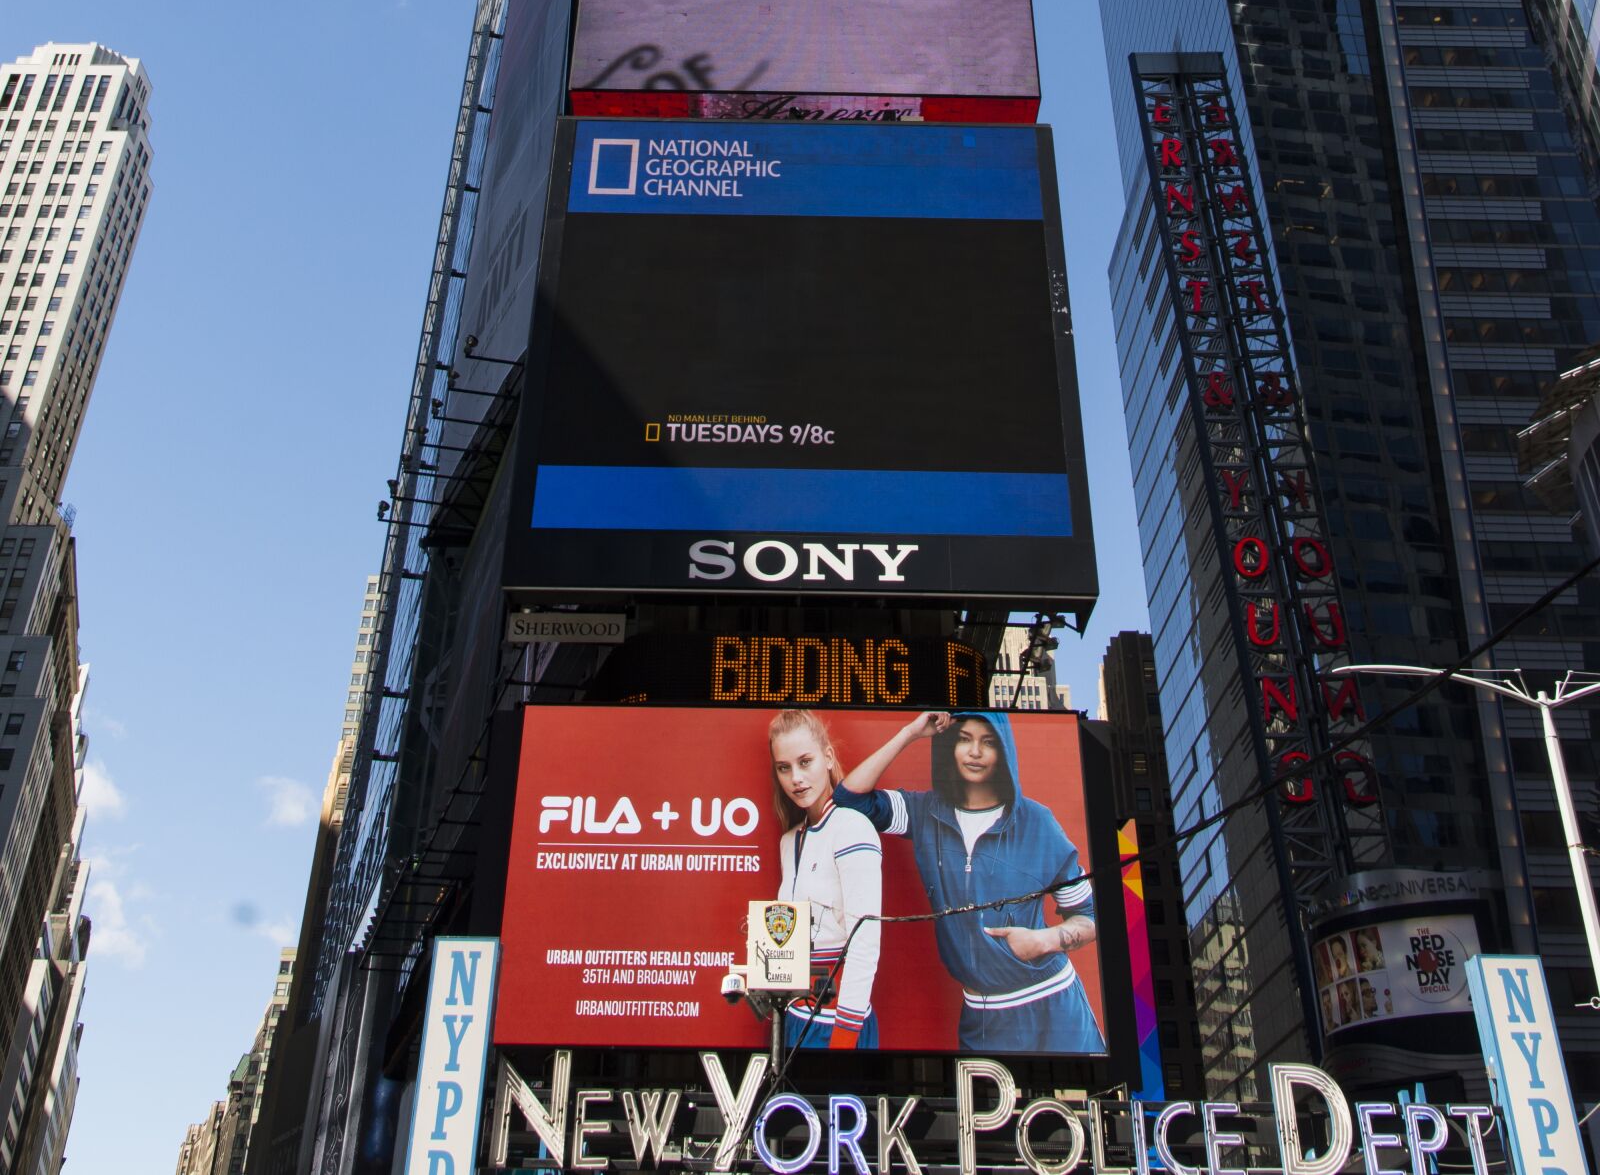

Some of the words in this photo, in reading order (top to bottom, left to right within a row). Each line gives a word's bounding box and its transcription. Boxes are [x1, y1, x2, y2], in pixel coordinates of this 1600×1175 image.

[648, 139, 754, 158] NATIONAL
[645, 158, 782, 178] GEOGRAPHIC
[643, 178, 743, 197] CHANNEL
[1204, 372, 1233, 406] &
[668, 414, 682, 423] NO
[683, 415, 705, 423] MAN
[706, 415, 729, 423] LEFT
[731, 415, 767, 424] BEHIND
[666, 423, 784, 444] TUESDAYS
[789, 423, 836, 446] 9/8c
[687, 538, 919, 583] SONY
[513, 619, 620, 636] SHERWOOD
[711, 636, 910, 704] BIDDING
[947, 641, 985, 707] F
[539, 795, 642, 834] FILA
[652, 801, 680, 831] +
[691, 797, 760, 837] UO
[536, 852, 620, 870] EXCLUSIVELY
[621, 853, 639, 870] AT
[640, 853, 683, 871] URBAN
[686, 854, 761, 873] OUTFITTERS
[1416, 927, 1430, 936] THE
[765, 948, 793, 958] SECURITY
[1409, 934, 1445, 953] RED
[546, 949, 583, 965] URBAN
[584, 950, 648, 966] OUTFITTERS
[649, 951, 691, 966] HERALD
[693, 951, 735, 967] SQUARE
[582, 968, 611, 984] 35TH
[612, 969, 635, 985] AND
[636, 969, 697, 986] BROADWAY
[767, 971, 791, 981] CAMERA
[1416, 968, 1451, 987] DAY
[1419, 985, 1451, 994] SPECIAL
[575, 1000, 700, 1017] URBANOUTFITTERS.COM
[1497, 968, 1569, 1175] NYP
[489, 1049, 683, 1170] NEW
[698, 1051, 923, 1175] YORK
[955, 1058, 1246, 1175] POLICE
[1268, 1062, 1494, 1175] DEPT
